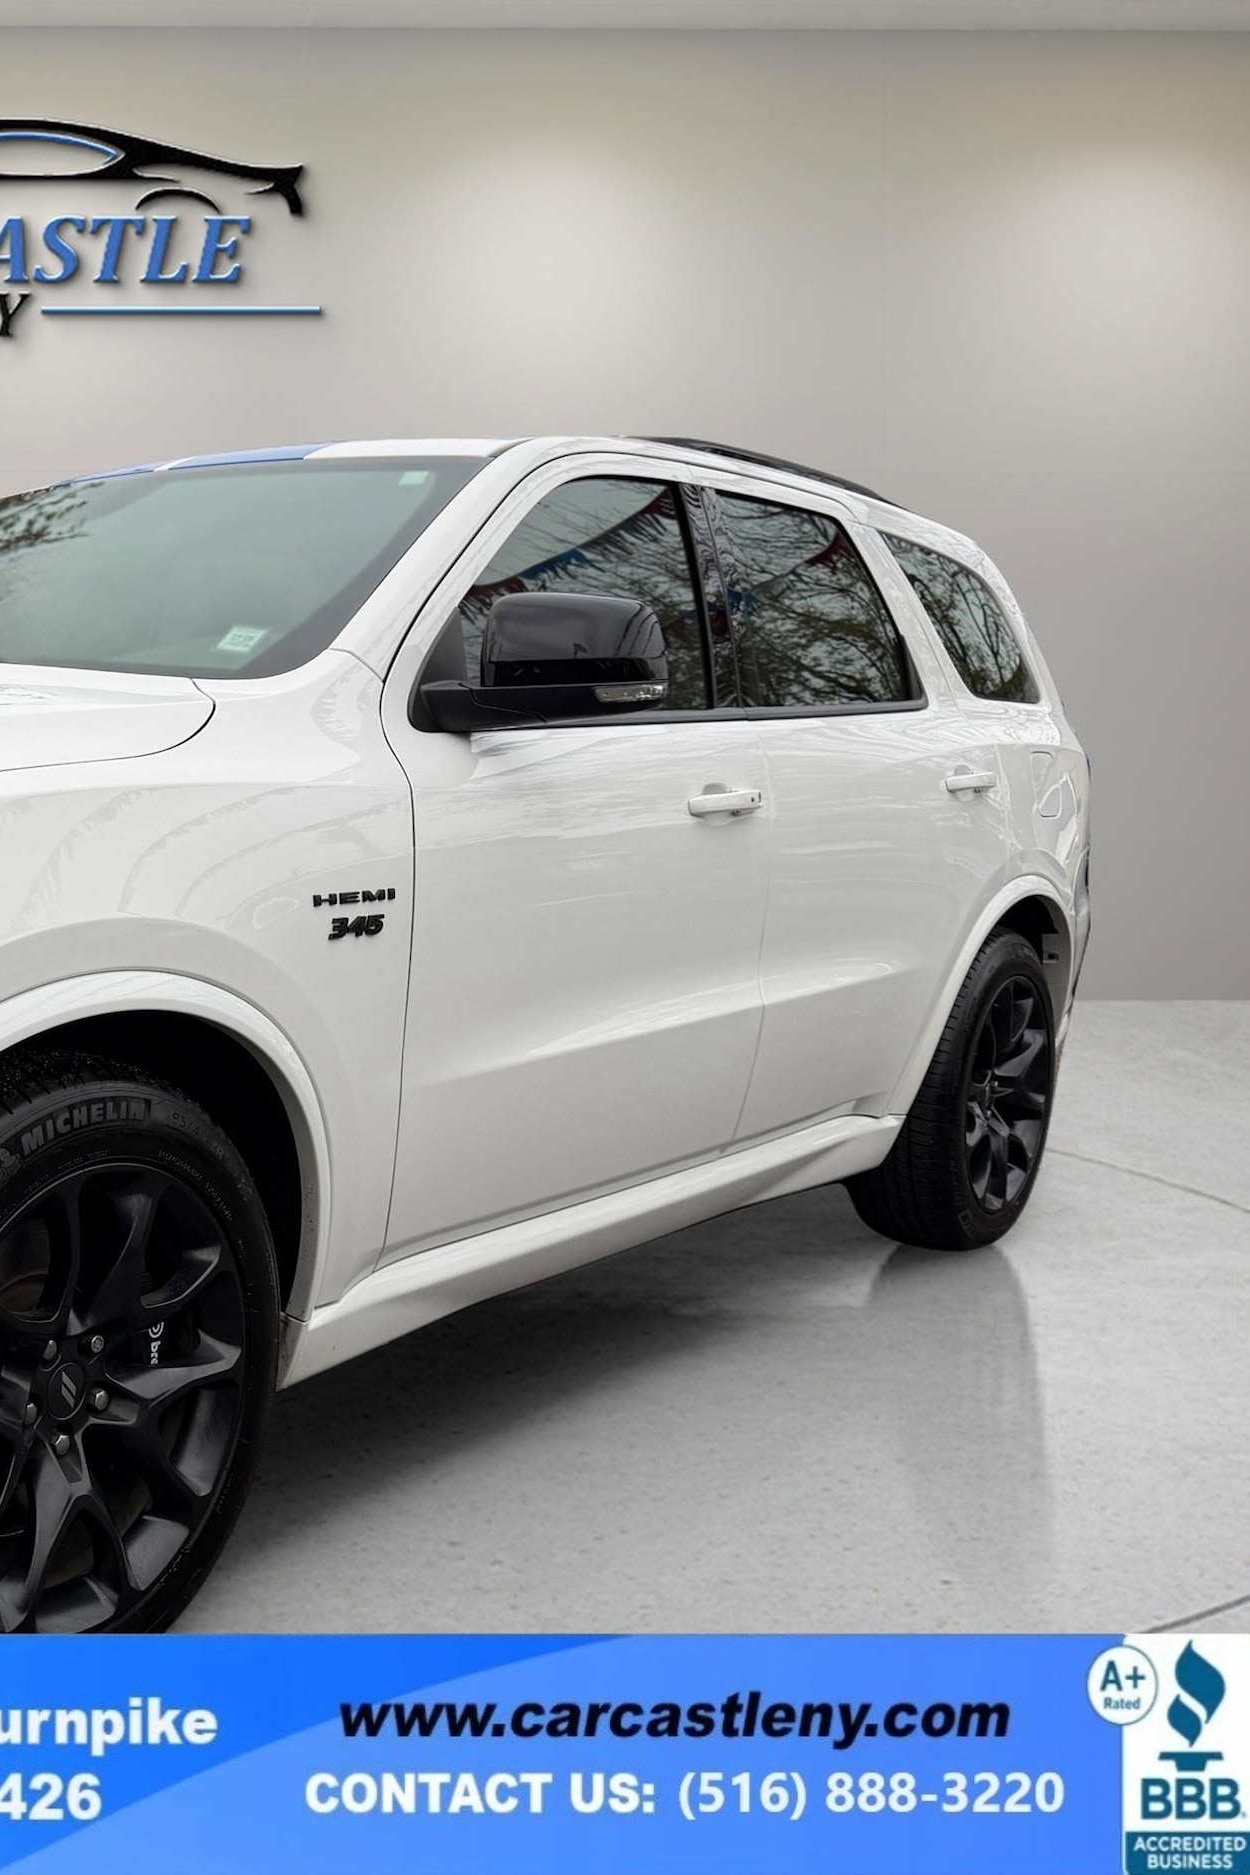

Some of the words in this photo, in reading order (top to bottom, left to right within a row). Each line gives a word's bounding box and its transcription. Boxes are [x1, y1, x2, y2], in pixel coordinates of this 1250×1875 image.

[312, 888, 396, 908] HEMI
[327, 913, 385, 941] 345
[20, 1100, 147, 1156] MICHELIN
